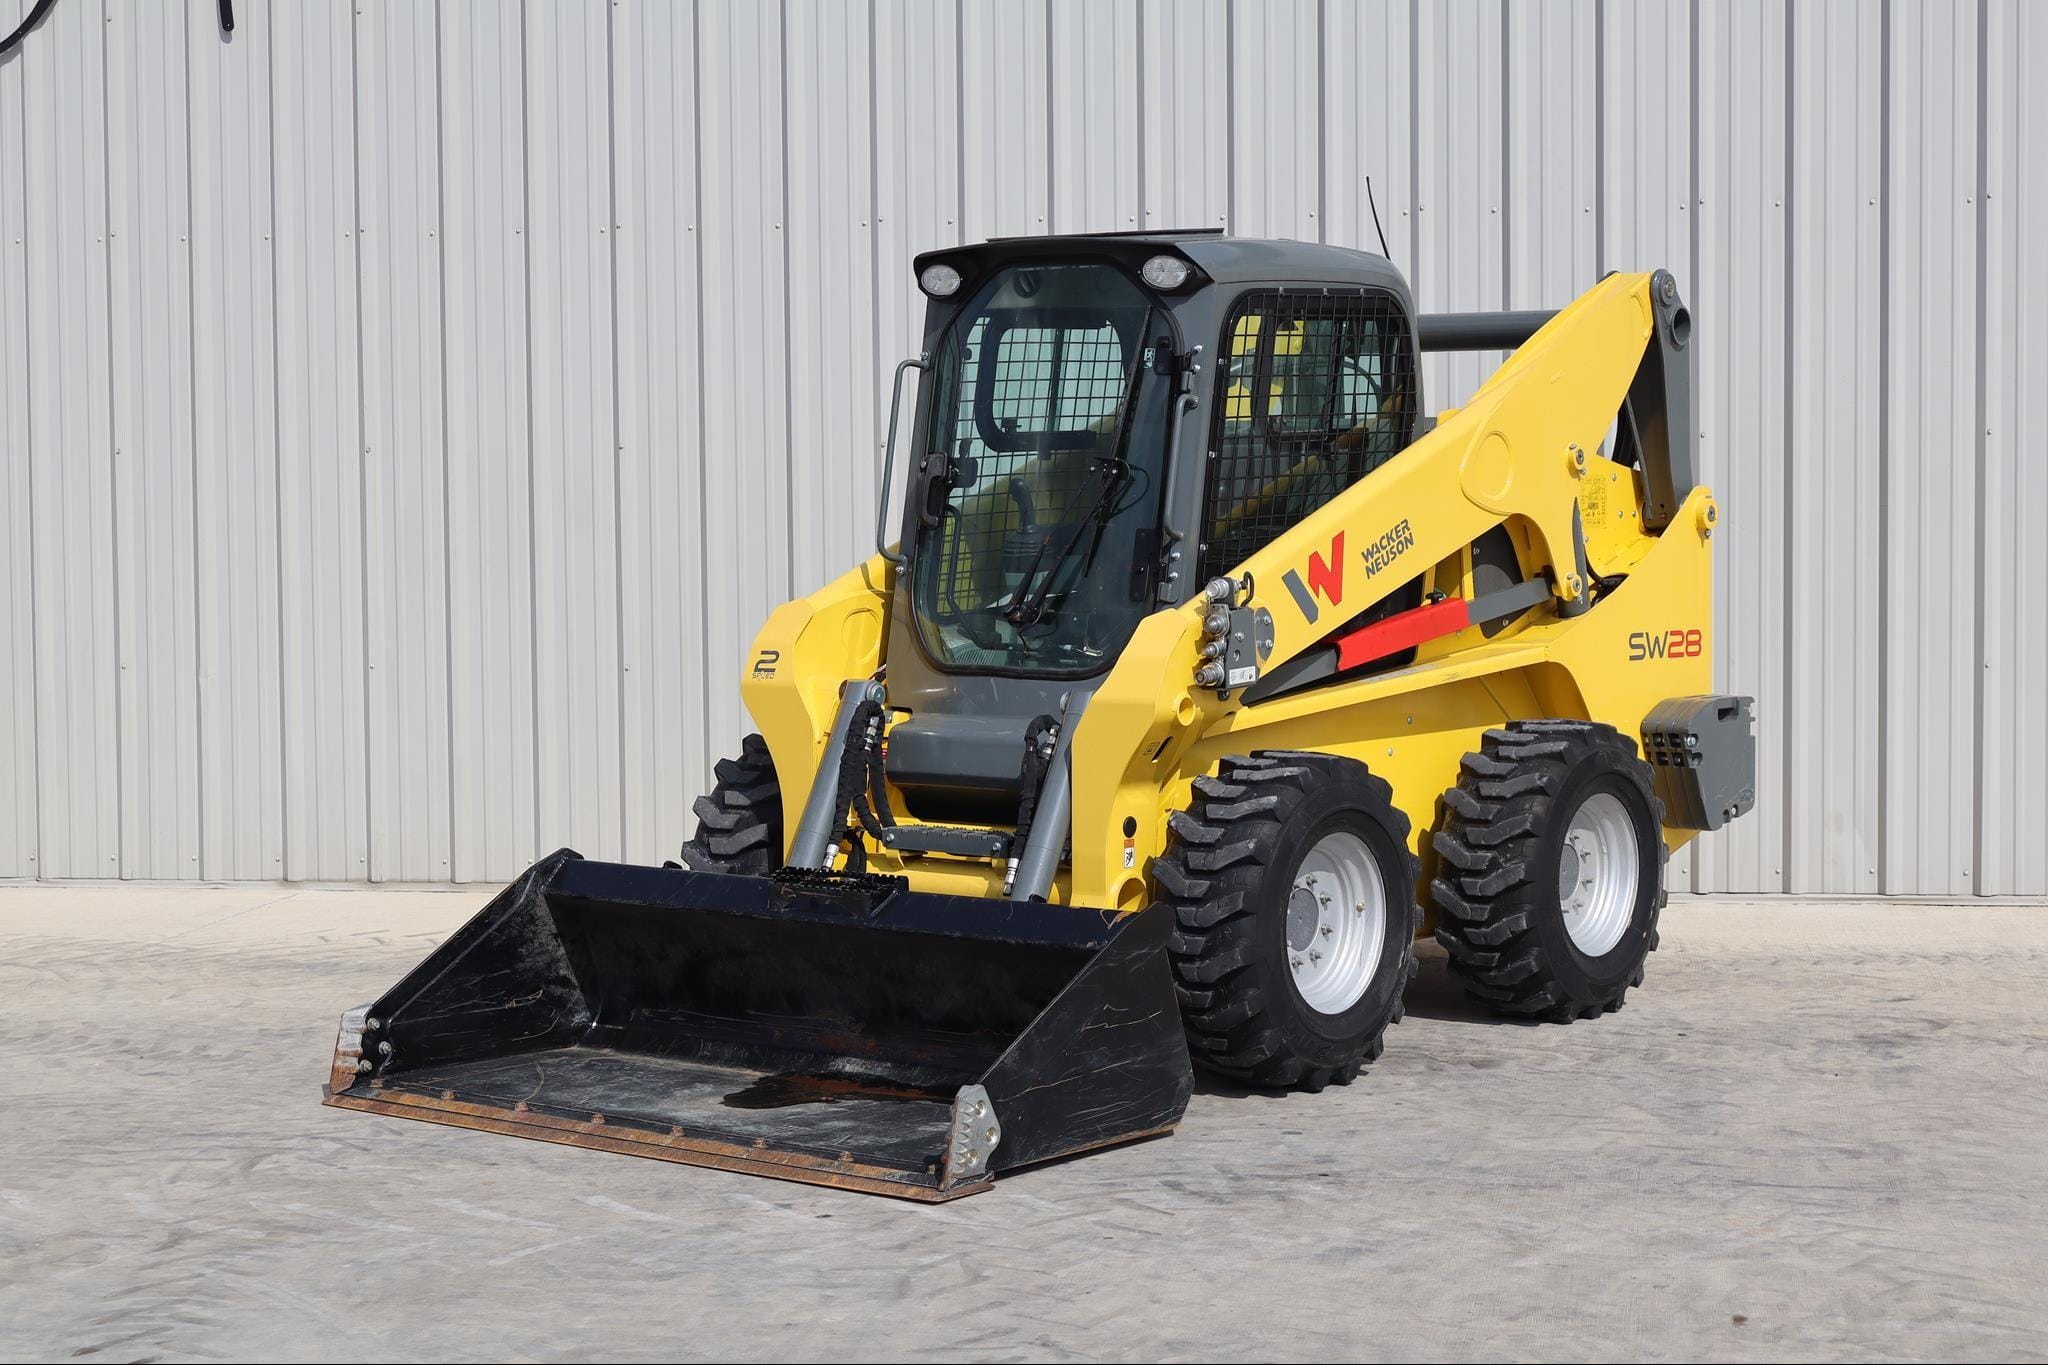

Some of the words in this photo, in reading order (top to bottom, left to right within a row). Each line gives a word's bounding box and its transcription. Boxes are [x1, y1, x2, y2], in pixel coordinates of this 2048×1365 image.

[1361, 518, 1412, 564] WACKER
[1365, 532, 1415, 580] NEUSON
[1281, 529, 1345, 625] W
[753, 650, 780, 672] 2
[1628, 629, 1702, 661] SW28
